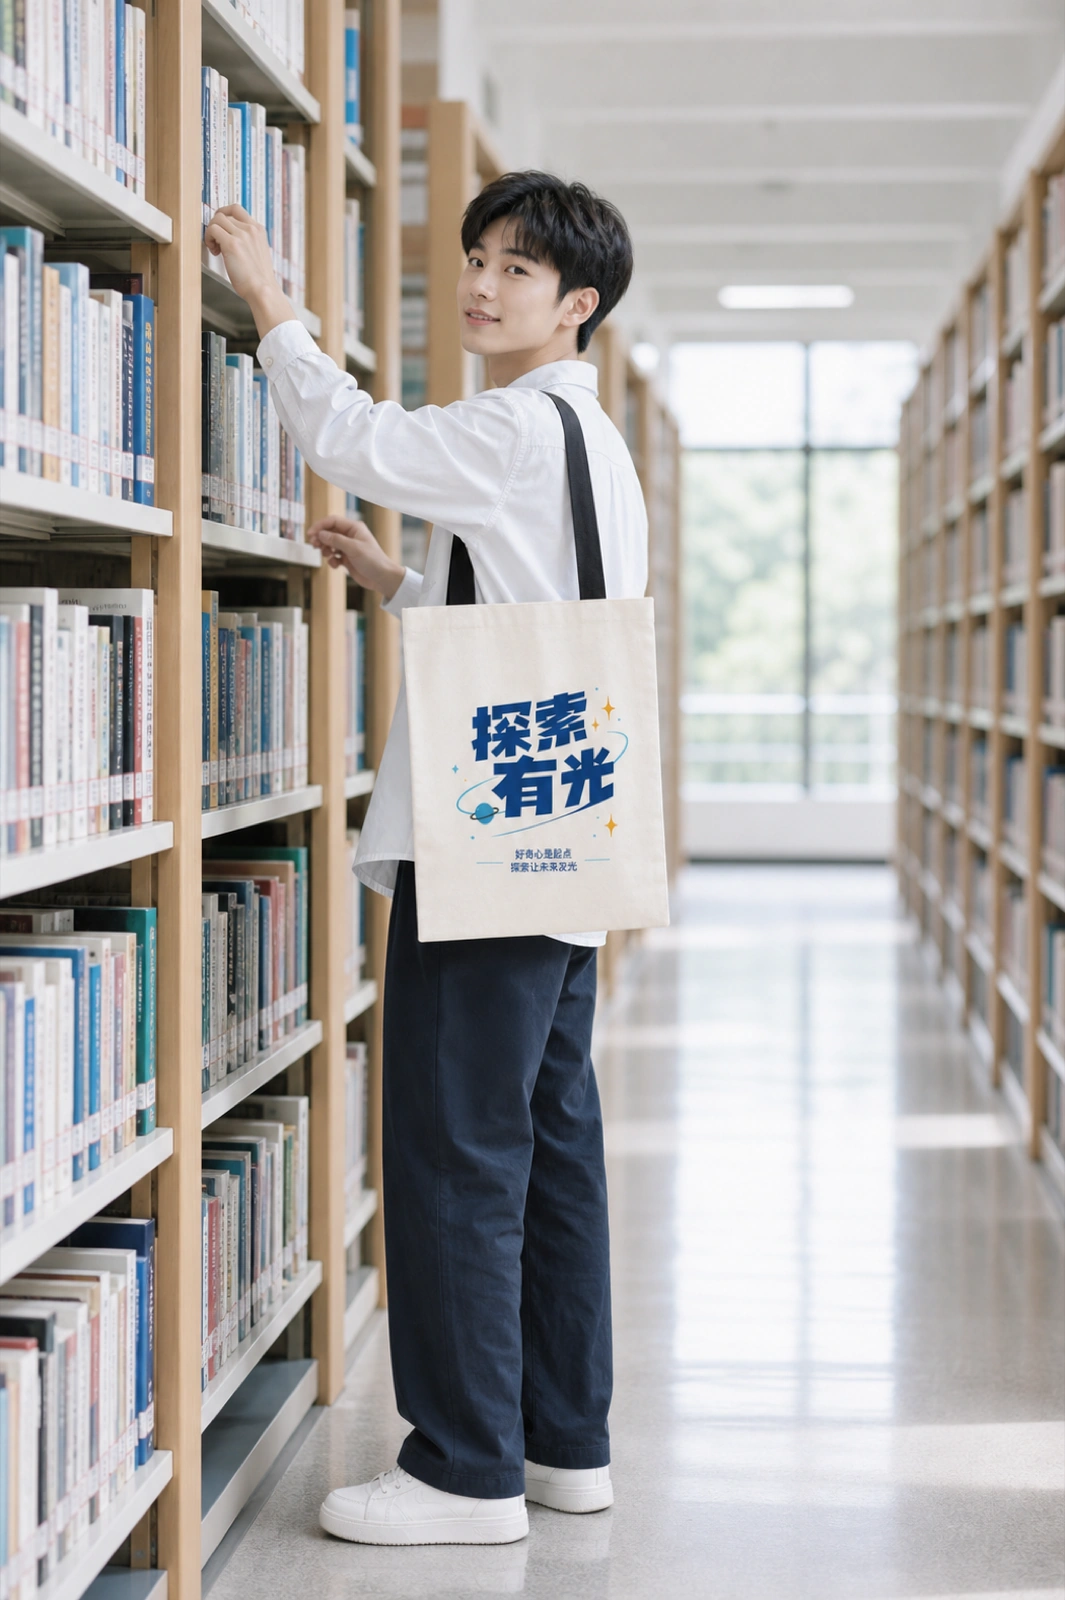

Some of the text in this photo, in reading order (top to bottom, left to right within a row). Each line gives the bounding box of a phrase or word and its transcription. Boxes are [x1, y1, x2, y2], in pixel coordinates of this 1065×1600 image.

[472, 691, 587, 761] 探索
[492, 748, 614, 818] 有光
[510, 861, 578, 873] 探索让未来发光
[514, 848, 572, 860] 好奇心是起点
